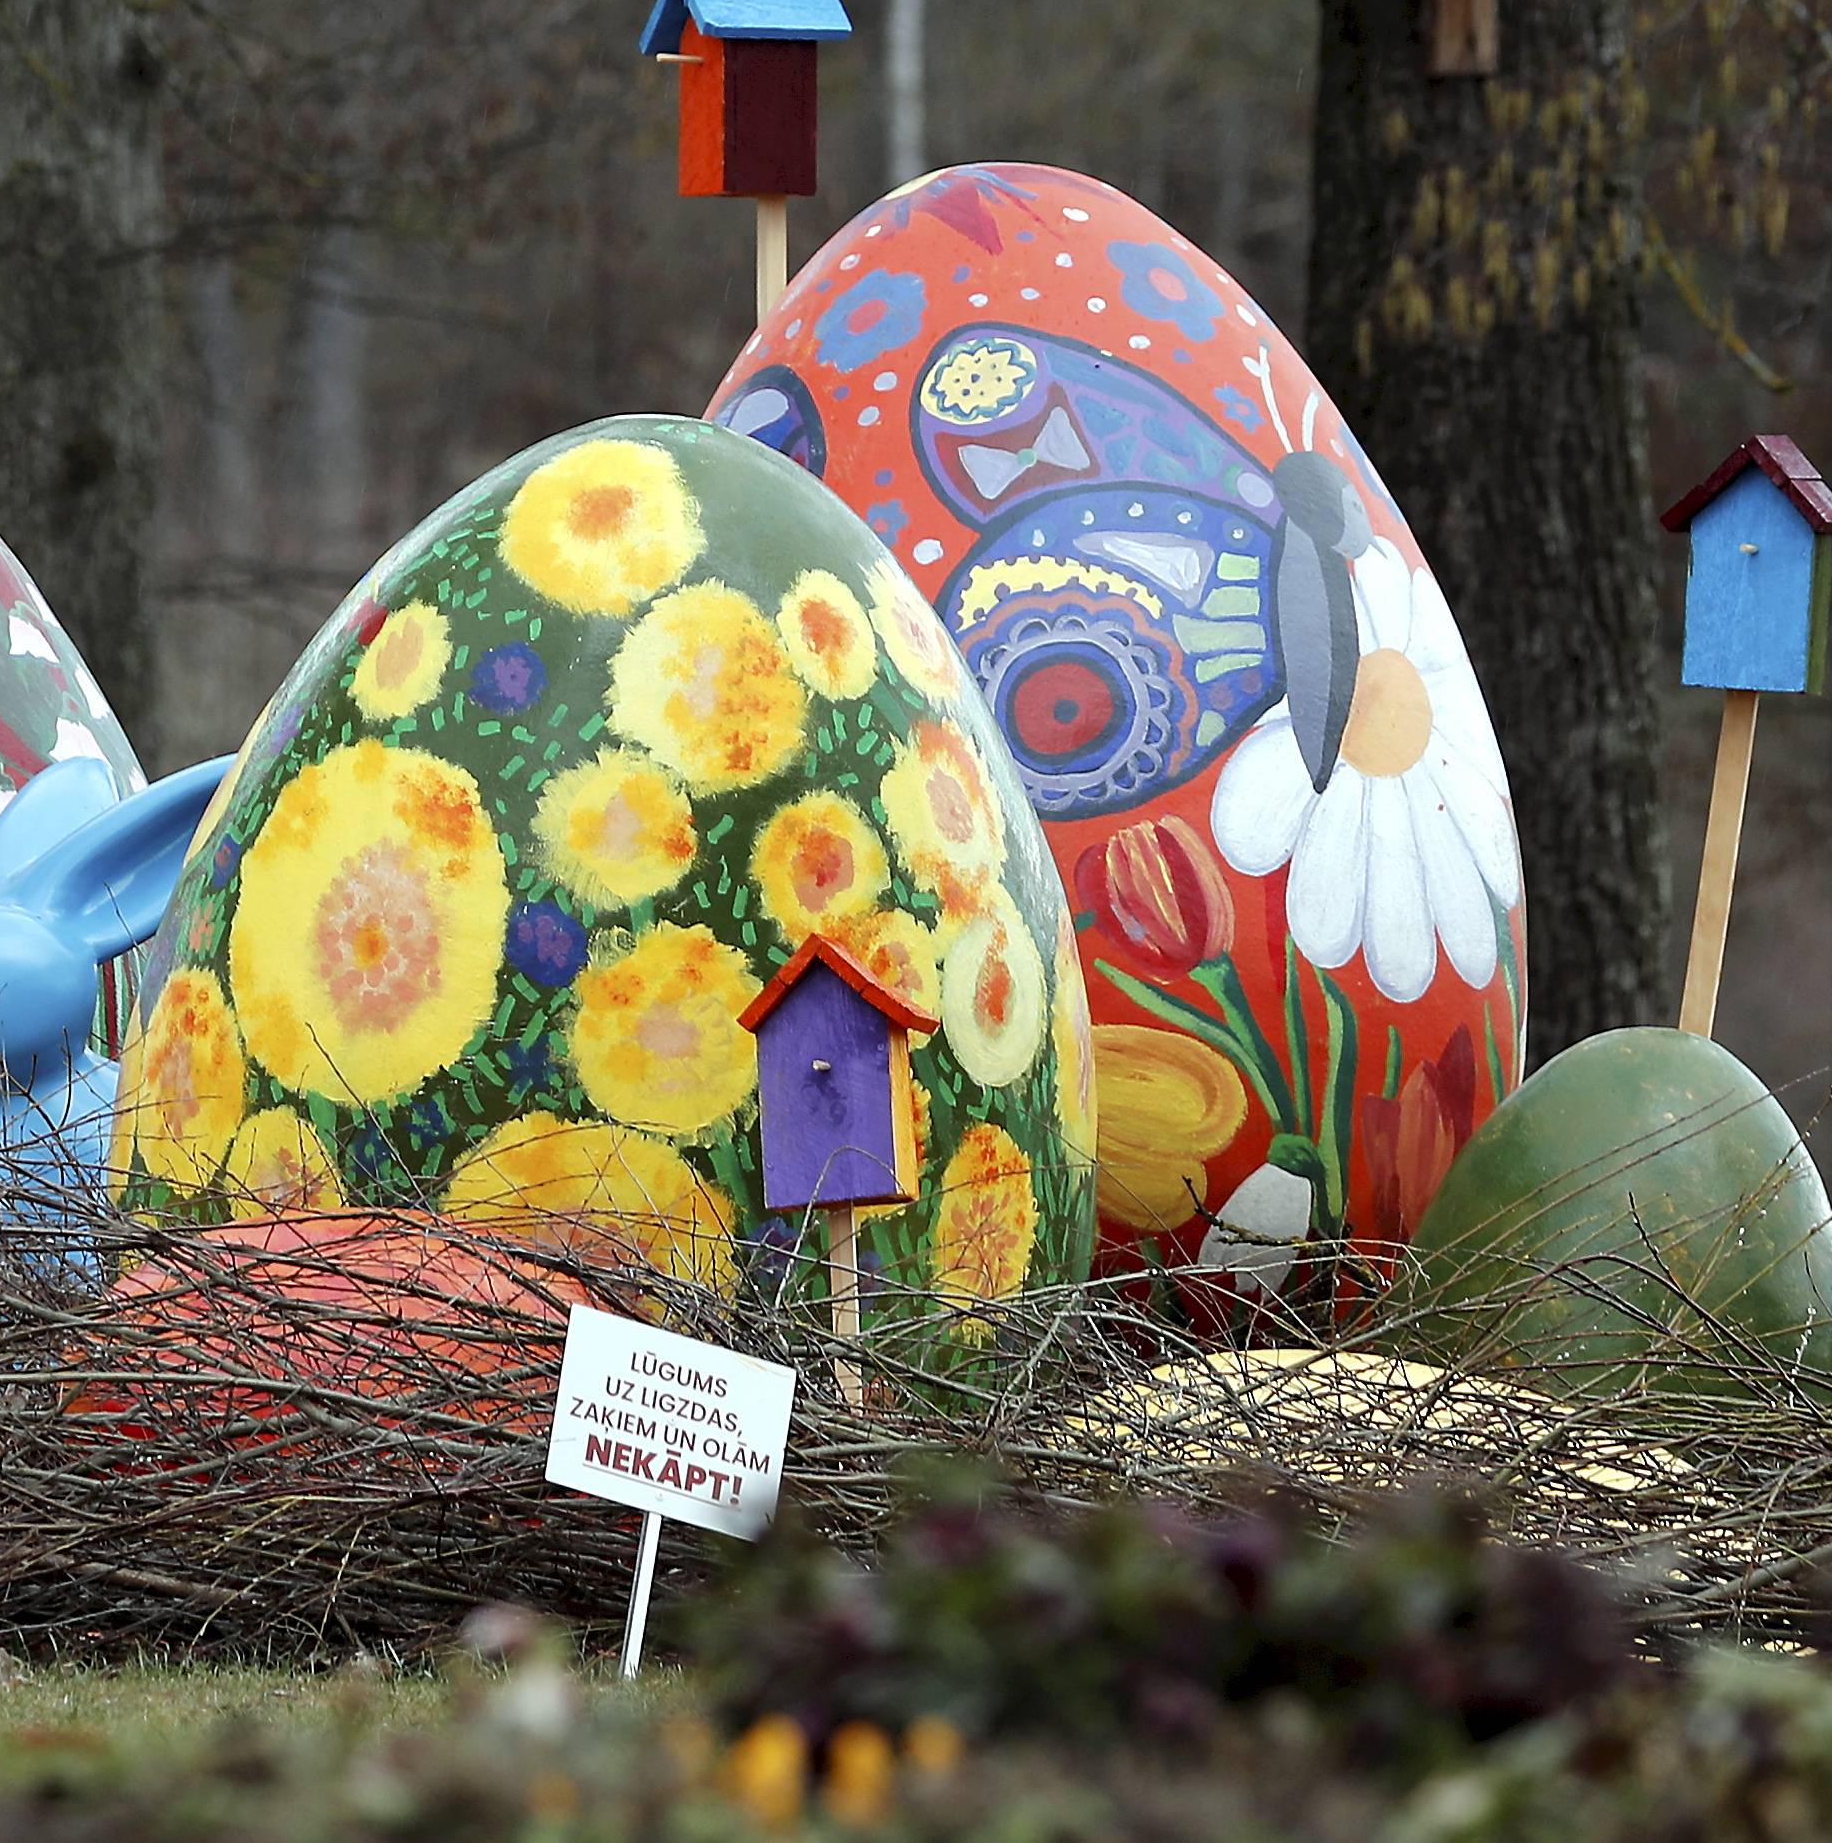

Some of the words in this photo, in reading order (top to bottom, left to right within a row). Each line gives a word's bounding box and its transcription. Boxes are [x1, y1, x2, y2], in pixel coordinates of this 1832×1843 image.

[605, 1375, 635, 1402] UZ
[641, 1386, 743, 1438] LIGZDAS,
[630, 1350, 728, 1398] LŪGUMS
[569, 1396, 657, 1440] ZAĶIEM
[663, 1424, 697, 1452] UN
[702, 1438, 770, 1474] OLĀM
[584, 1433, 743, 1505] NEKĀPT!
